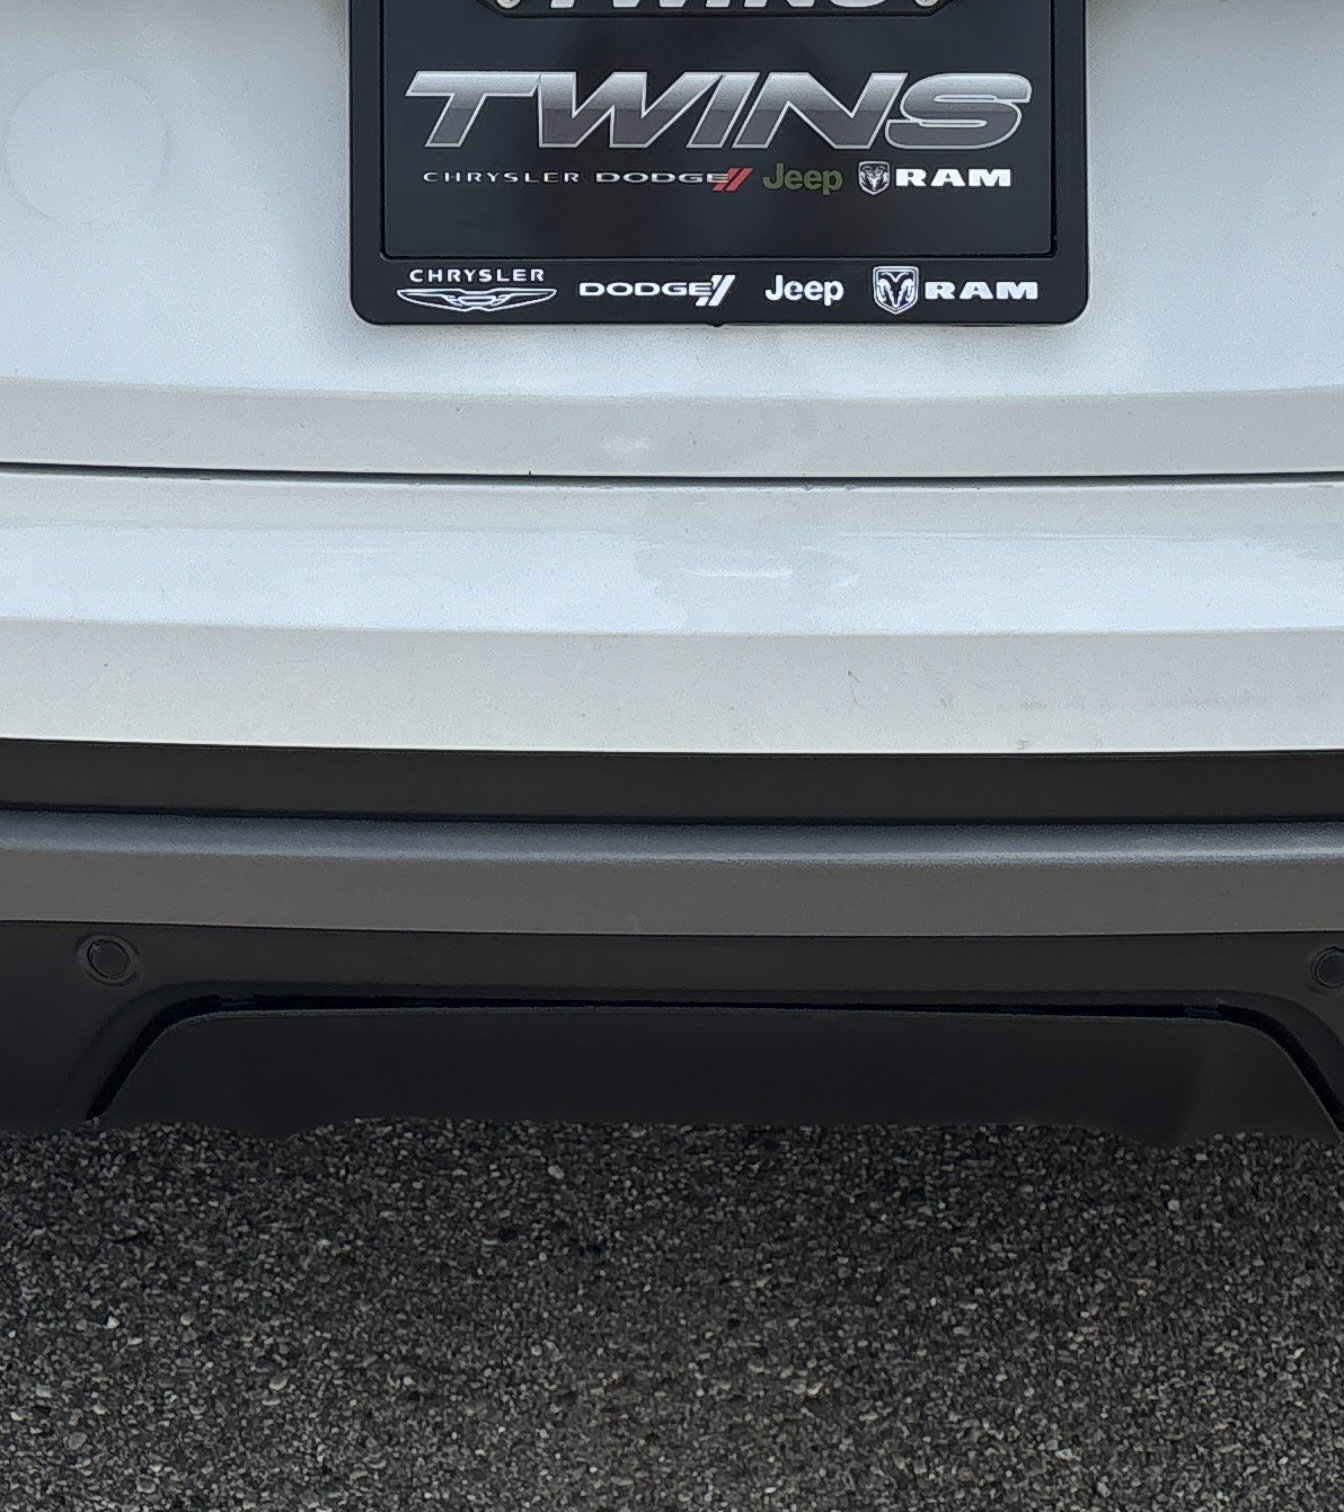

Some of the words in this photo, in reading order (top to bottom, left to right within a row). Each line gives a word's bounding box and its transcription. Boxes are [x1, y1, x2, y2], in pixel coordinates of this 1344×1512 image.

[405, 70, 1033, 149] TWINS
[422, 171, 580, 184] CHRYSLER
[594, 171, 730, 185] DODGE
[762, 162, 844, 196] Jeep
[895, 168, 1012, 188] RAM
[408, 267, 546, 284] CHRYSLER
[578, 281, 714, 298] DODGE
[764, 274, 845, 306] Jeep
[924, 281, 1039, 300] RAM
